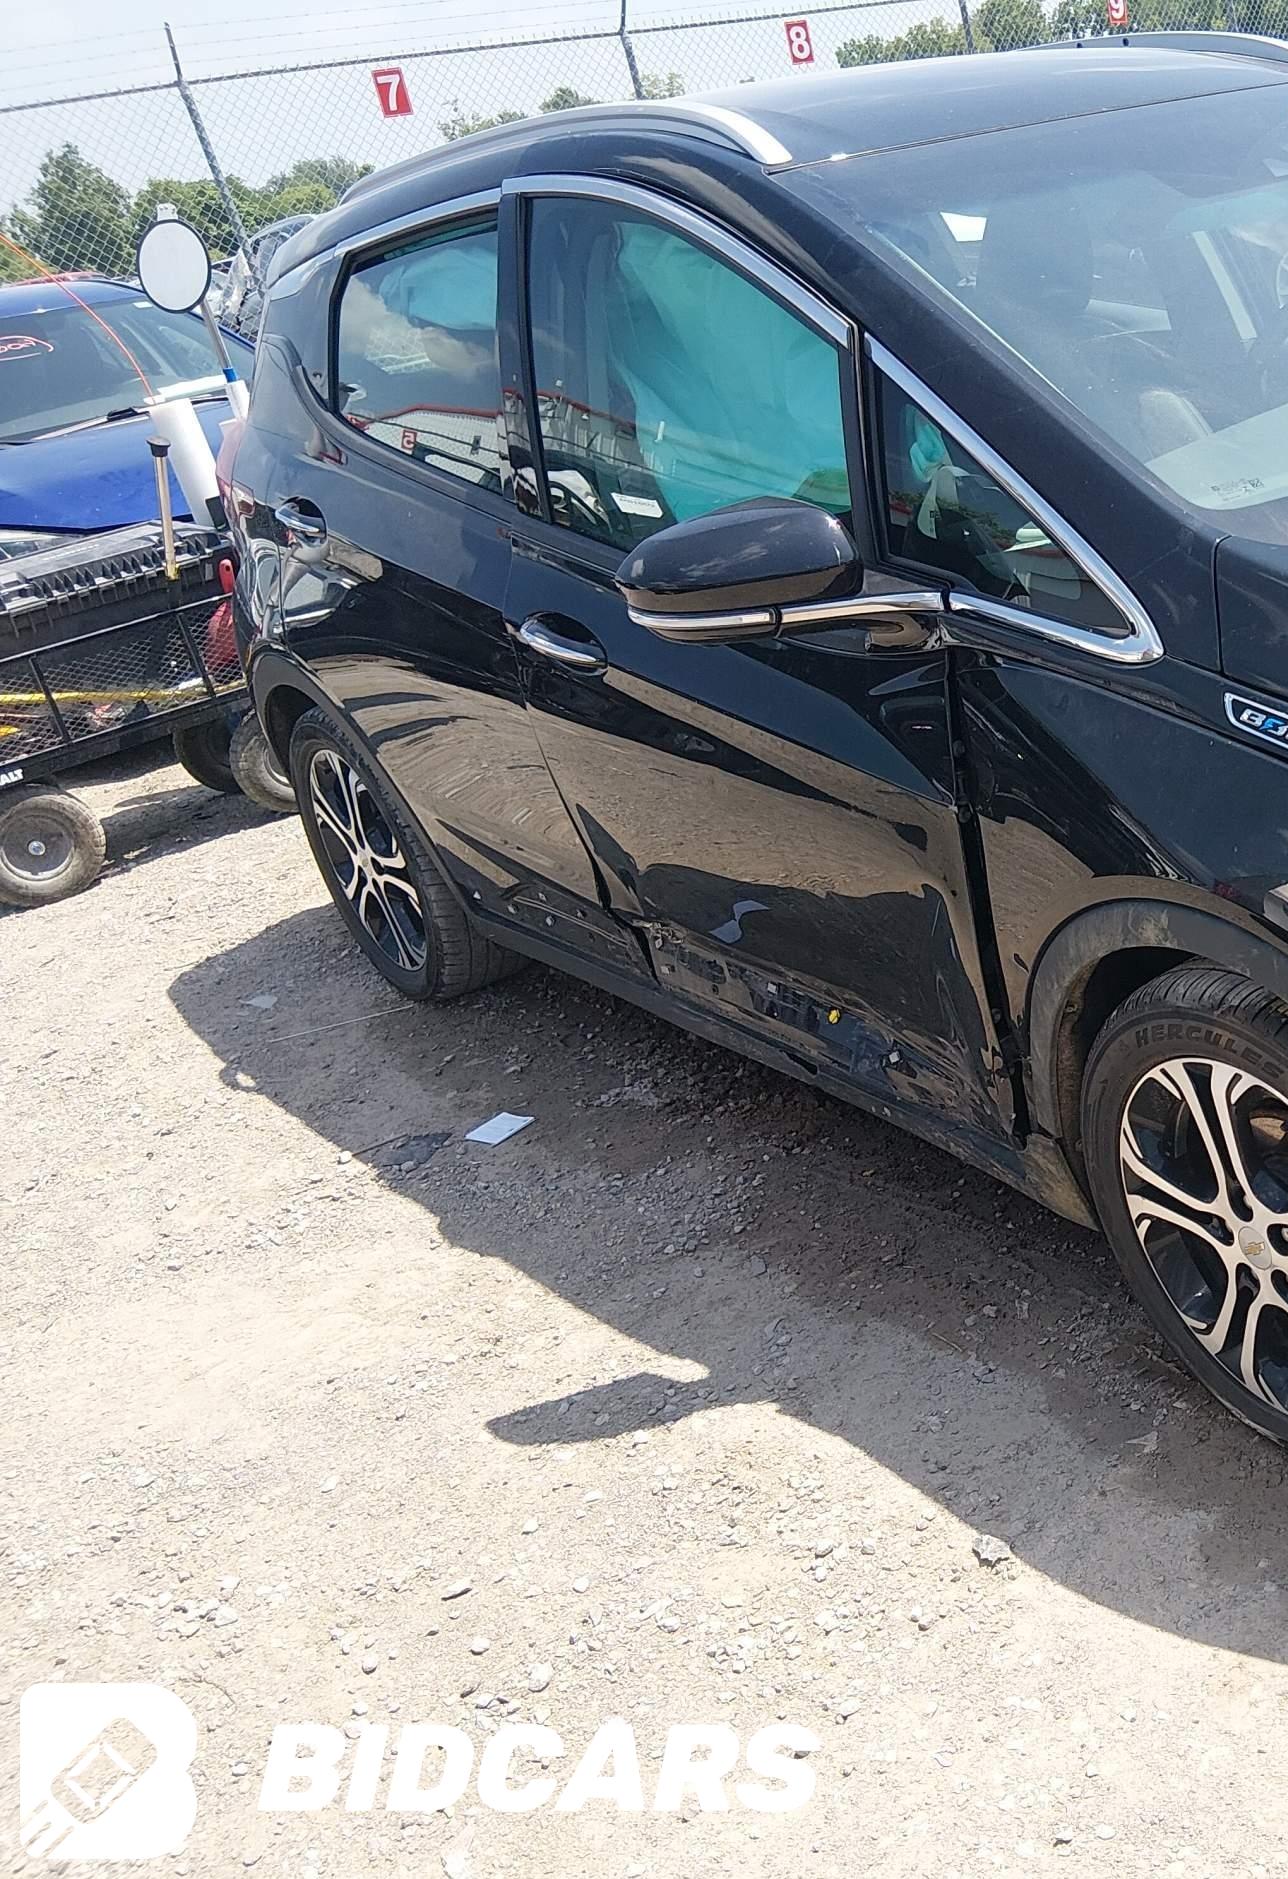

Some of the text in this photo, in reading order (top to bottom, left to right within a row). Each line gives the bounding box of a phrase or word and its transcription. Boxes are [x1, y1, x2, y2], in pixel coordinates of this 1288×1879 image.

[1110, 0, 1125, 19] 9
[790, 26, 810, 59] 8
[376, 74, 400, 111] 7
[1135, 1023, 1284, 1079] HERCULES
